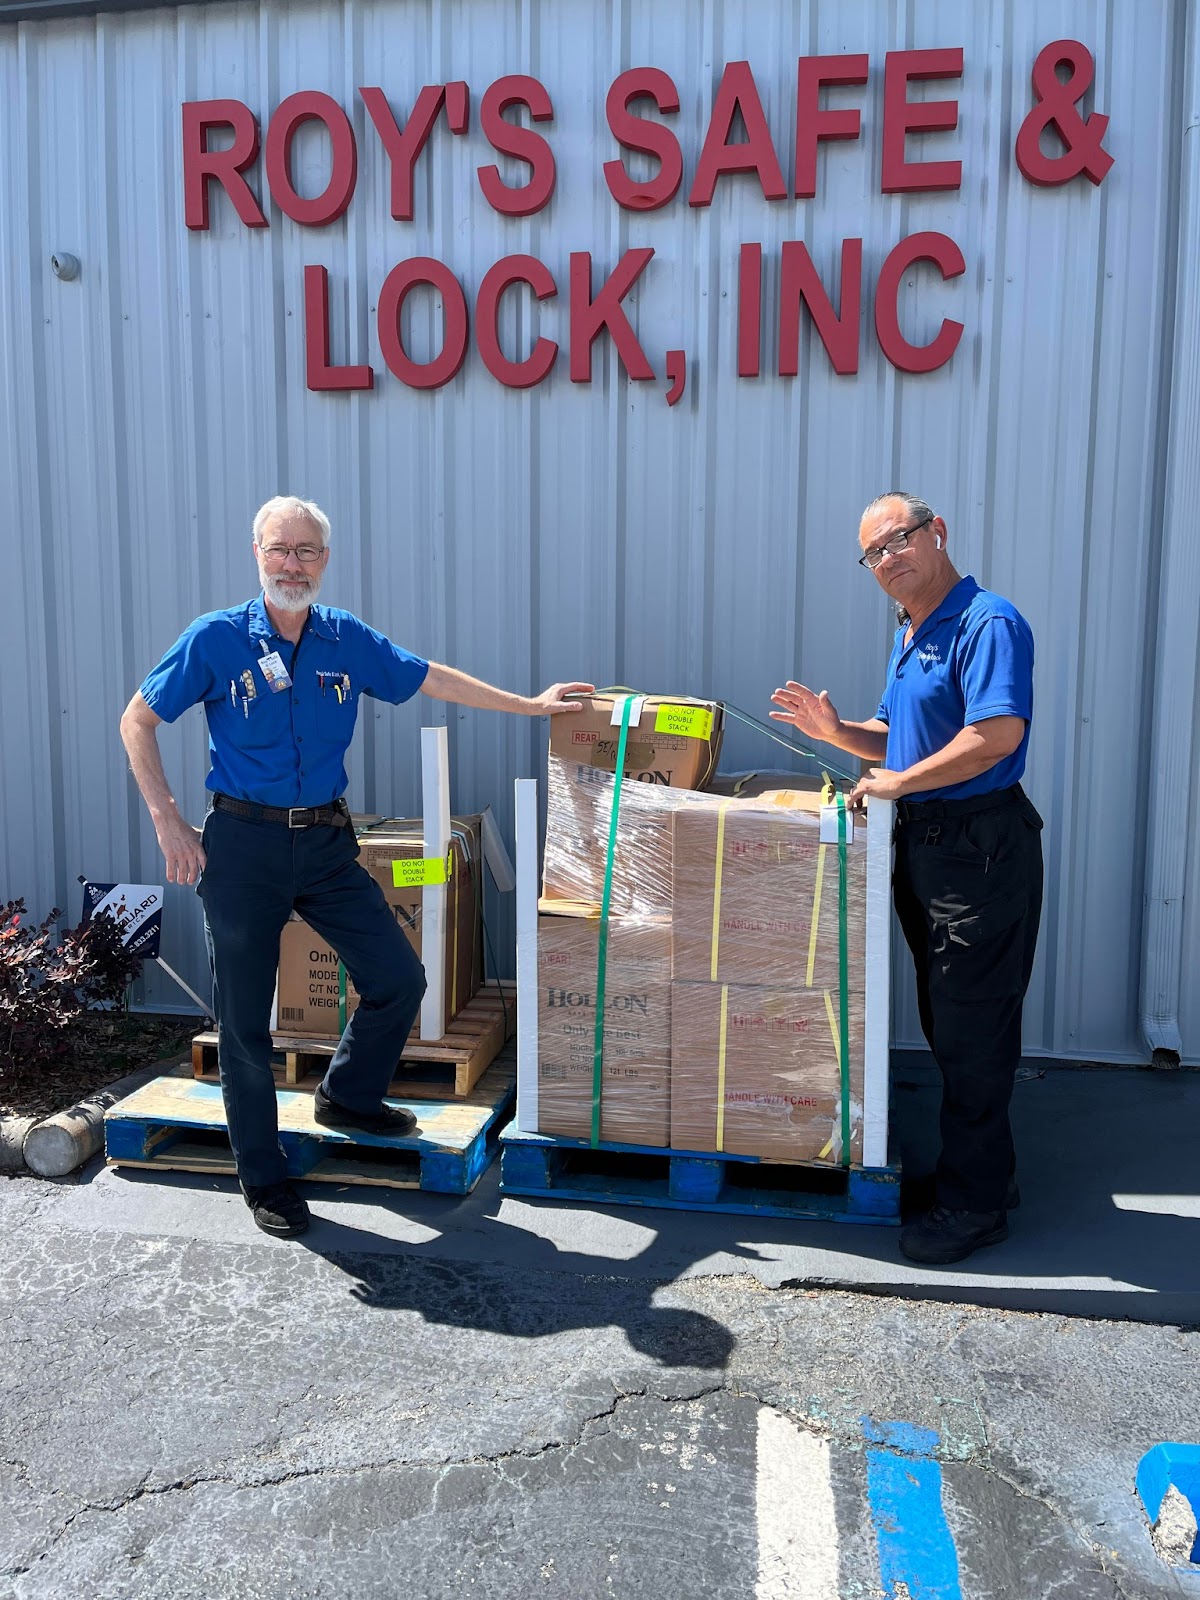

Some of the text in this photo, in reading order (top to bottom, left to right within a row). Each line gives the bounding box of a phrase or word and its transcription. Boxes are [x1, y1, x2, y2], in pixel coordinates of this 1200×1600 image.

[182, 39, 1115, 231] ROY'S SAFE &
[304, 231, 966, 407] LOCK, INC
[681, 708, 696, 716] NOT
[667, 715, 694, 724] DOUBLE
[668, 723, 690, 732] STACK
[575, 733, 597, 743] REAR
[576, 763, 674, 787] HOON
[402, 867, 426, 875] DOUBLE
[309, 951, 340, 966] Only
[309, 983, 324, 993] C/T
[308, 996, 341, 1008] WEIGH
[546, 987, 649, 1016] HOLON
[569, 1063, 593, 1073] WEIGH
[790, 1095, 818, 1107] CARE
